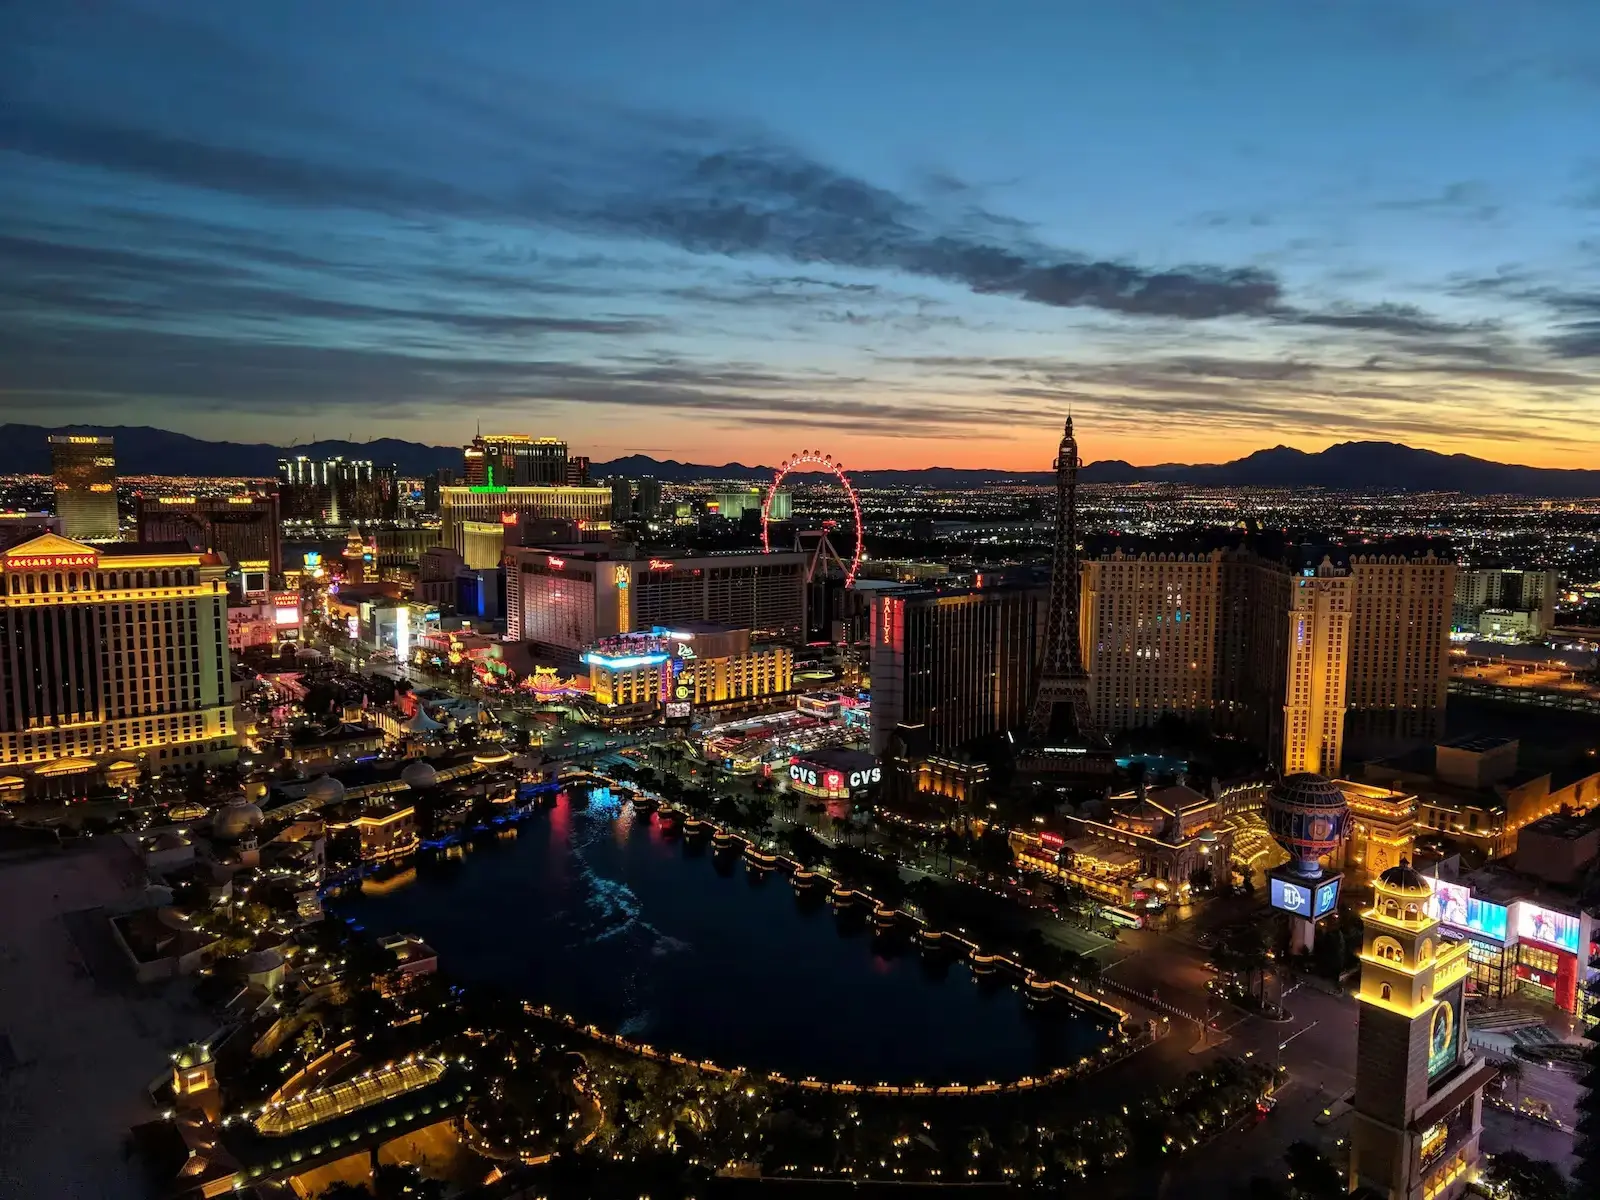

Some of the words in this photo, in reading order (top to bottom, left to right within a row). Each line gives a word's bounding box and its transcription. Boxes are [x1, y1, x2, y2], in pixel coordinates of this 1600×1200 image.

[69, 436, 98, 444] TRUMP
[6, 559, 52, 567] CAESARS
[55, 556, 94, 565] PALACE
[790, 765, 817, 786] CVS
[850, 767, 881, 787] CVS
[1469, 939, 1497, 952] URBAN
[1530, 973, 1541, 983] M
